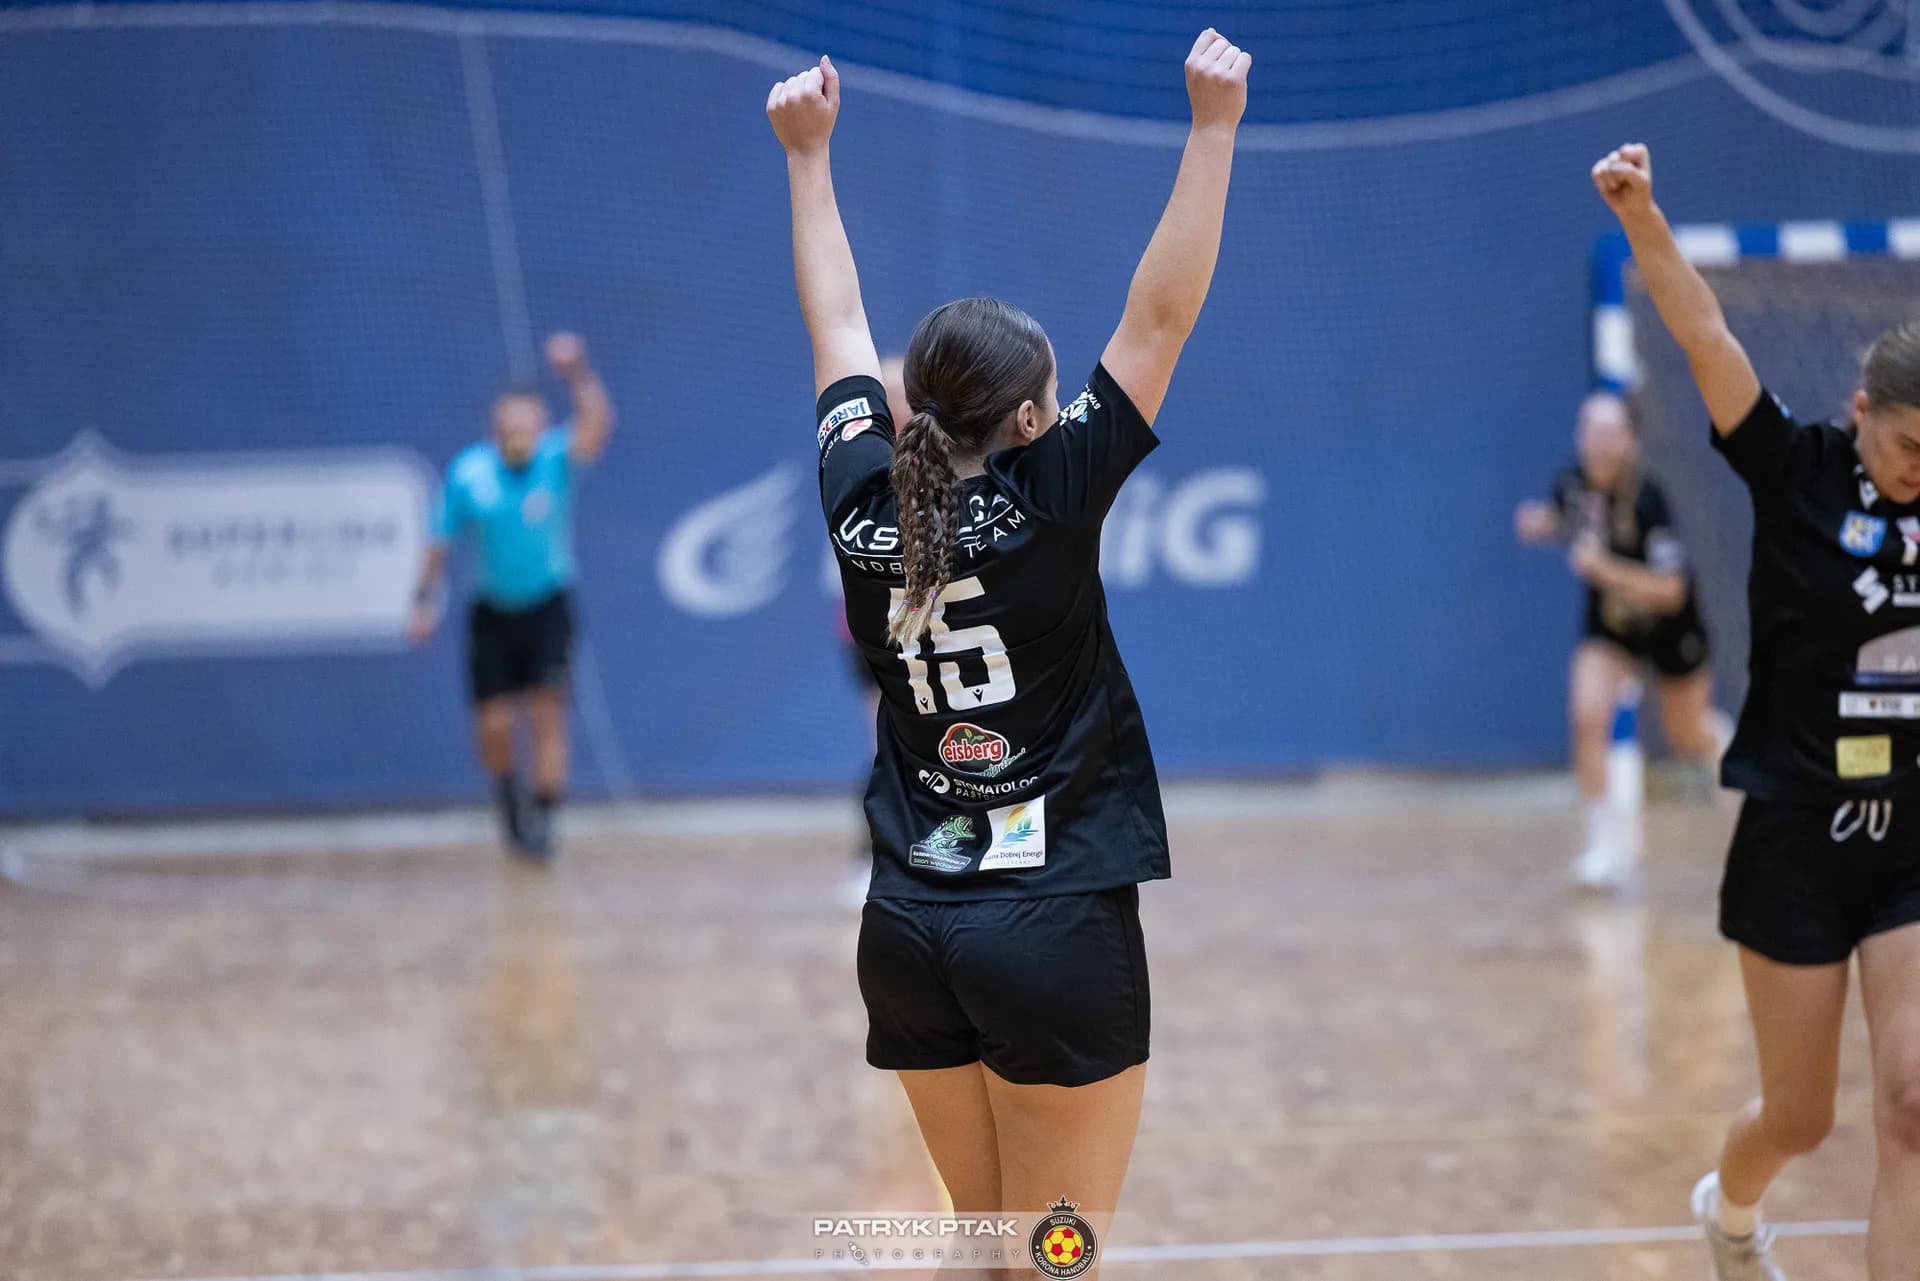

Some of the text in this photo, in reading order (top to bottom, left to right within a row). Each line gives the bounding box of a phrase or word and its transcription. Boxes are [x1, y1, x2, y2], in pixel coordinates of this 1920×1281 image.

[963, 509, 1027, 558] TEAM
[886, 575, 1017, 715] 15
[943, 738, 1003, 762] eisberg
